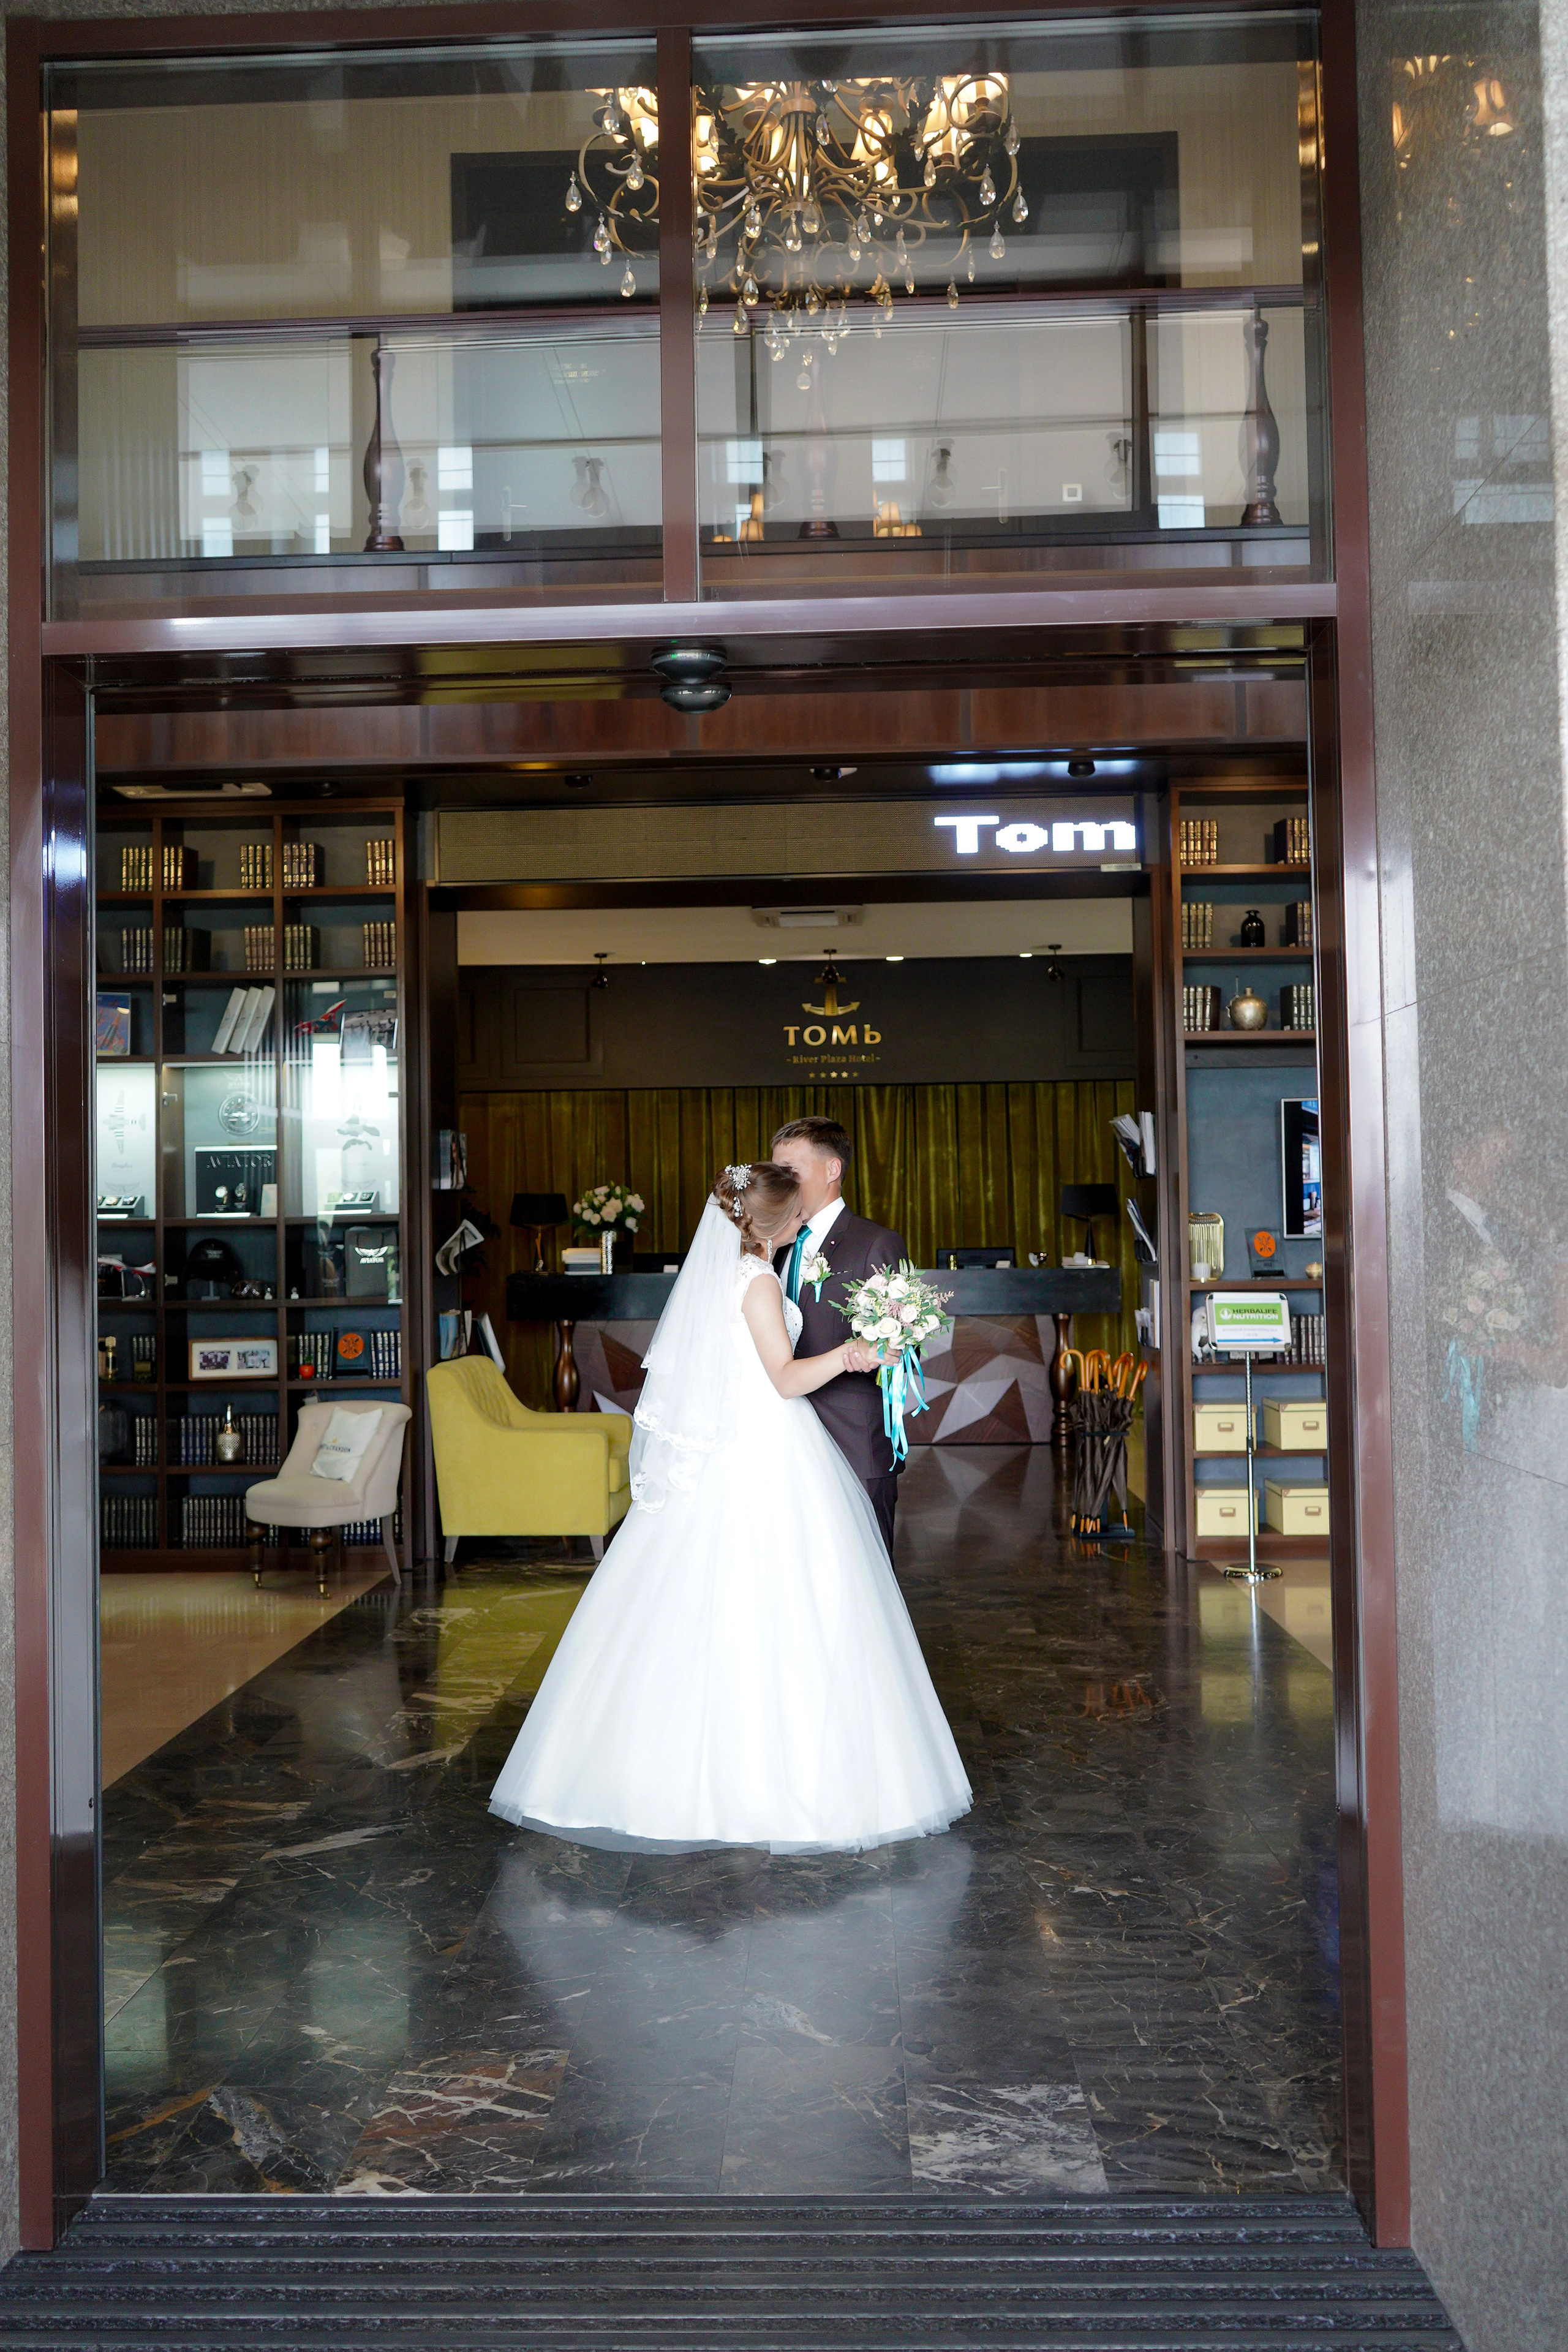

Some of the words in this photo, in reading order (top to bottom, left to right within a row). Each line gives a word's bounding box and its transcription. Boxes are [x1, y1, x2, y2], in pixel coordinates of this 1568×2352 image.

[934, 815, 1136, 854] Tom
[783, 1023, 882, 1046] ТОМЬ
[820, 1054, 847, 1063] Plaza
